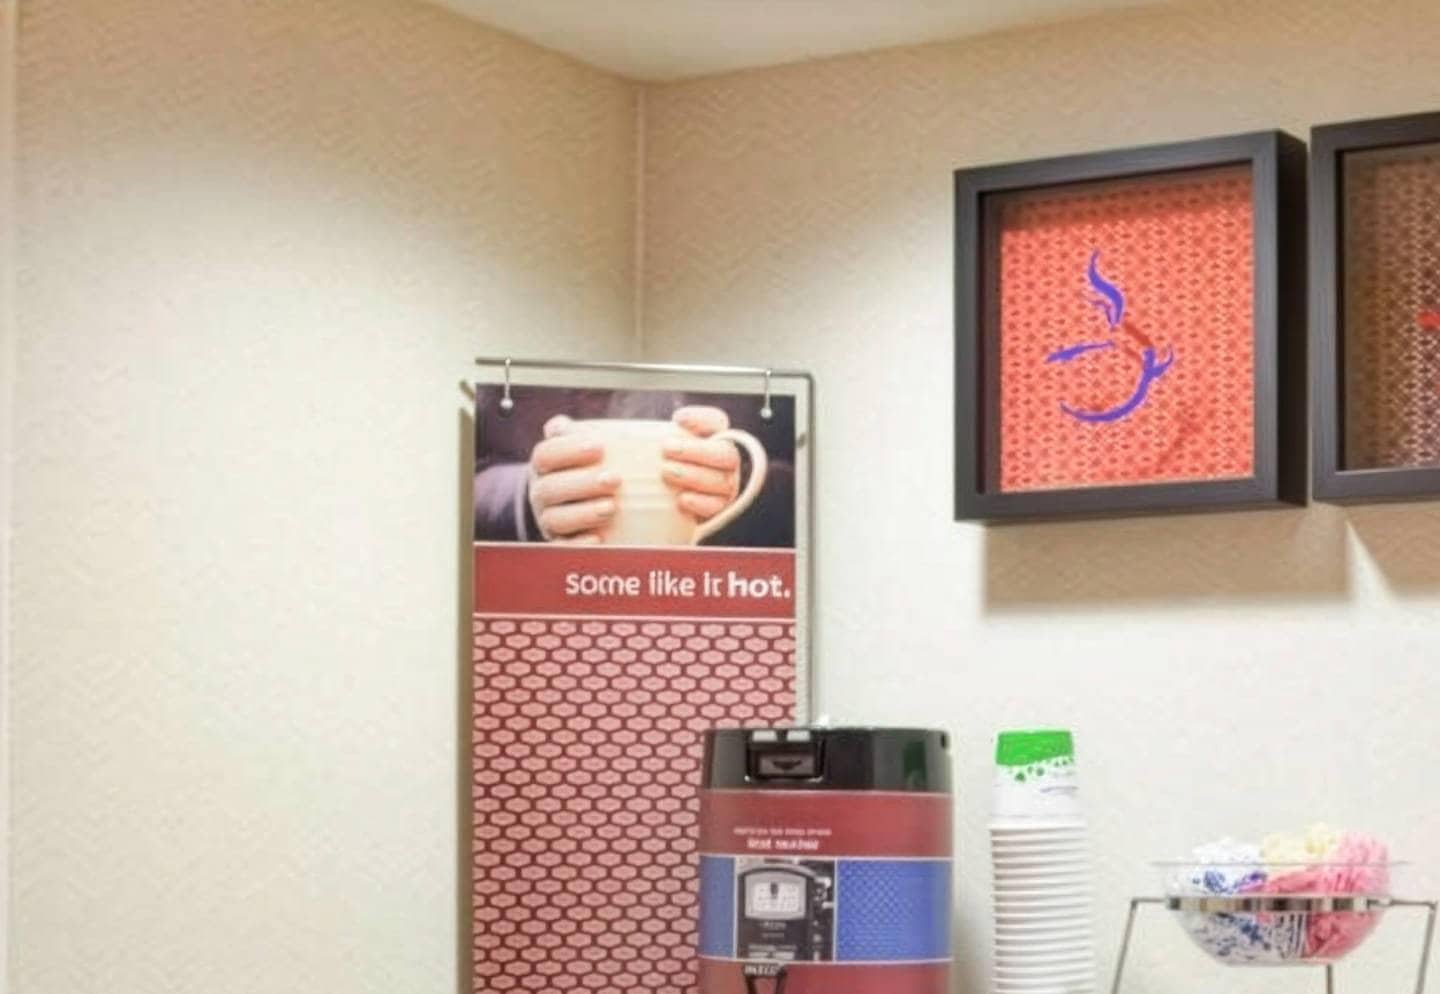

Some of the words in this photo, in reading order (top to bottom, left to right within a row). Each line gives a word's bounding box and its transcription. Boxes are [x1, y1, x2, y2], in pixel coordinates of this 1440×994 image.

[565, 572, 641, 596] some
[648, 570, 696, 597] like
[727, 571, 792, 599] hot.
